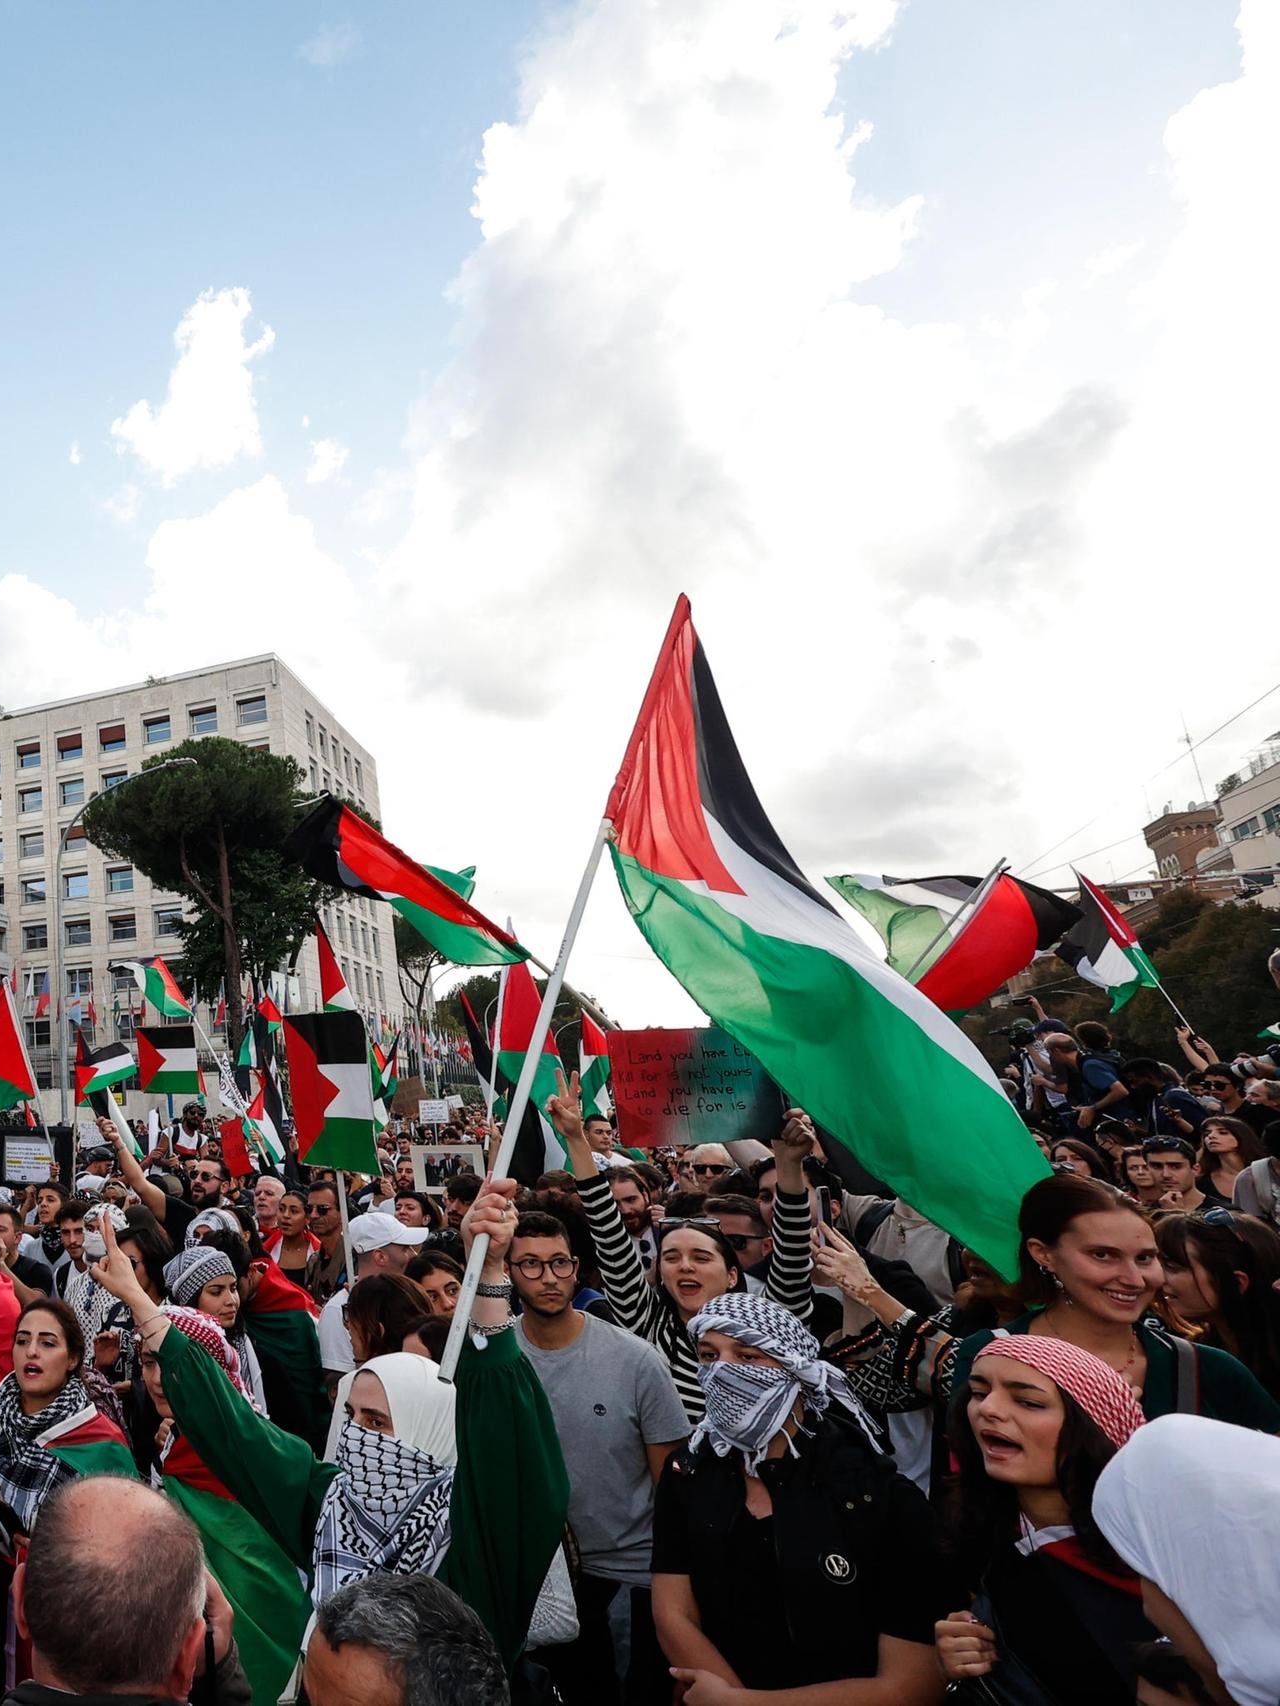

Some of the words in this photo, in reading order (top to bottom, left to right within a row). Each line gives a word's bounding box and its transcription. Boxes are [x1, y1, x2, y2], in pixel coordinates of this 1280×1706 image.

[628, 1049, 662, 1065] Land
[670, 1051, 694, 1070] you
[701, 1045, 728, 1060] have
[640, 1069, 660, 1082] for
[688, 1063, 711, 1080] not
[715, 1067, 753, 1084] yours
[624, 1087, 656, 1101] Land
[668, 1087, 692, 1103] you
[701, 1083, 735, 1095] have
[662, 1100, 691, 1117] die
[697, 1096, 723, 1114] for
[730, 1100, 746, 1111] is
